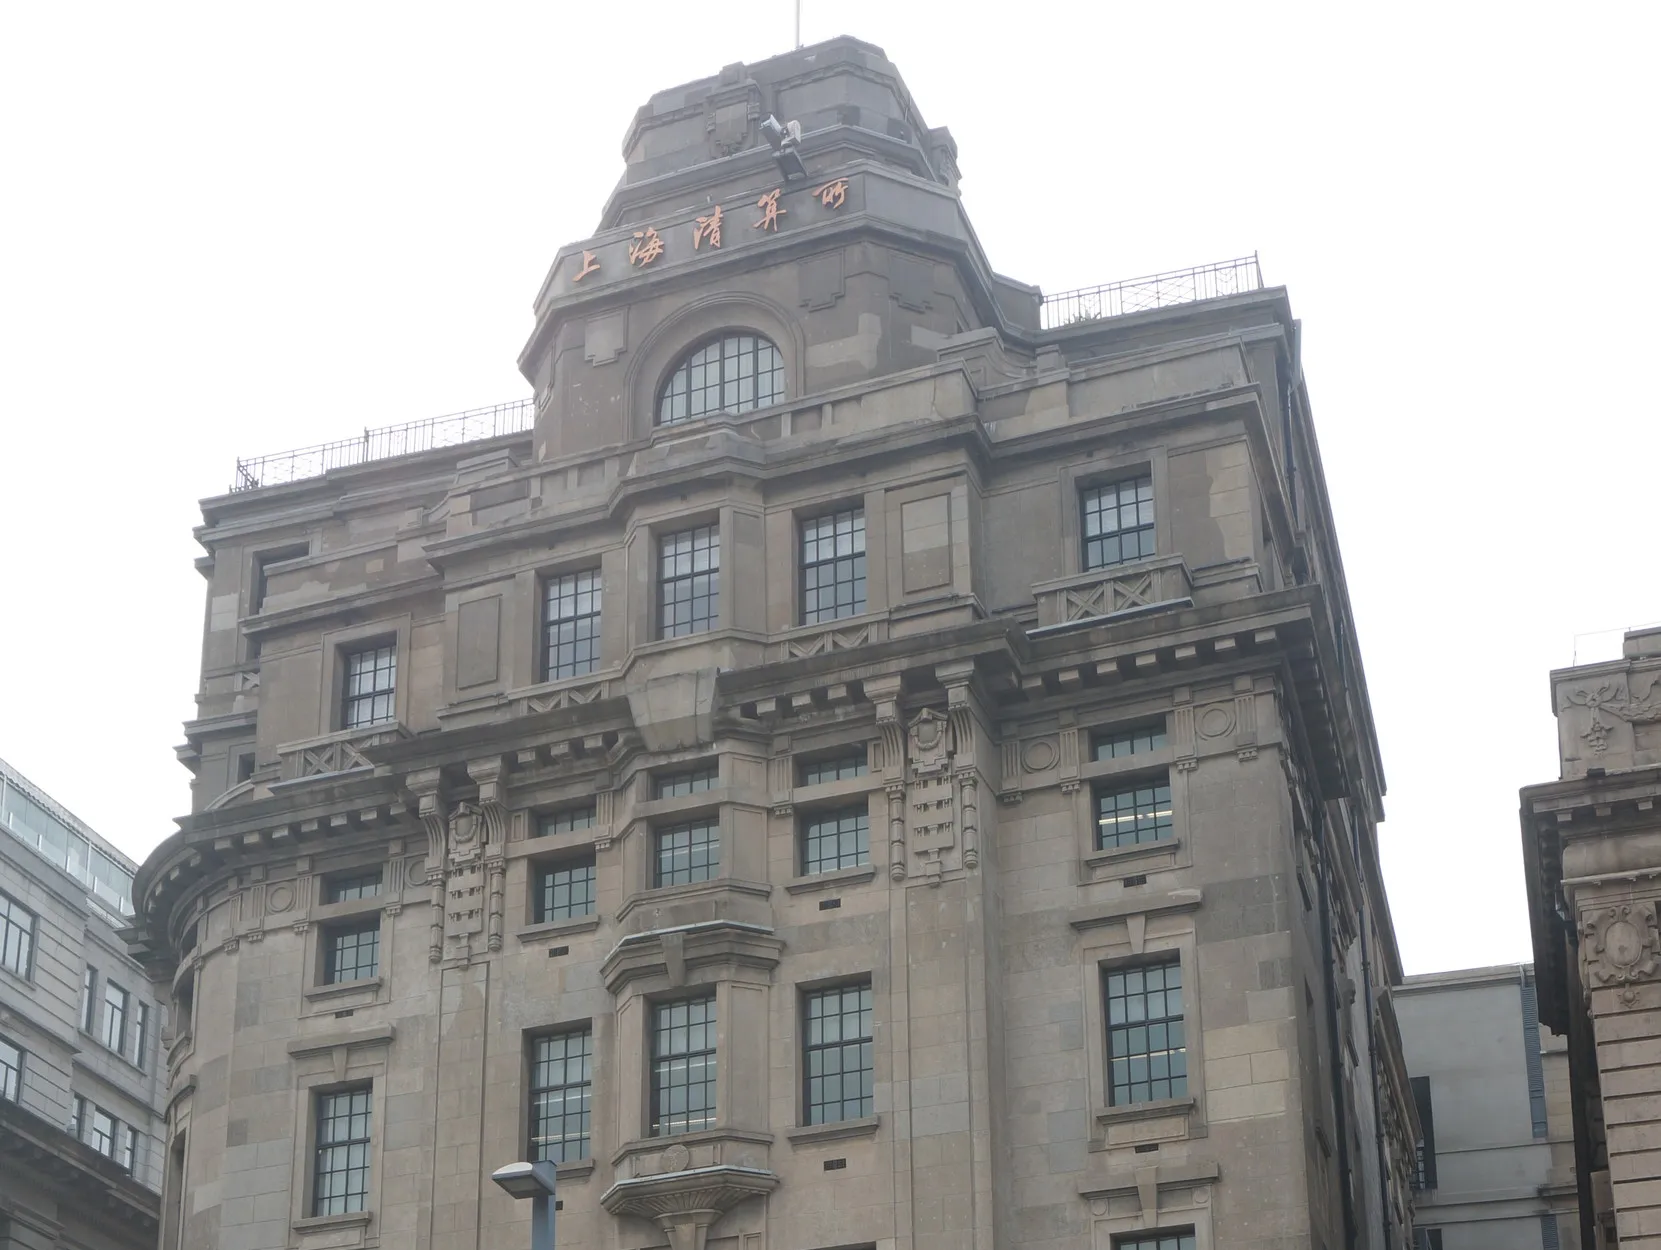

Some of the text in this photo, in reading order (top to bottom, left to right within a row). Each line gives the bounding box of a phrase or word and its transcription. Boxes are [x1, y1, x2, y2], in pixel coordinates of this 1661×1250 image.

[572, 177, 848, 282] 上海清算所
